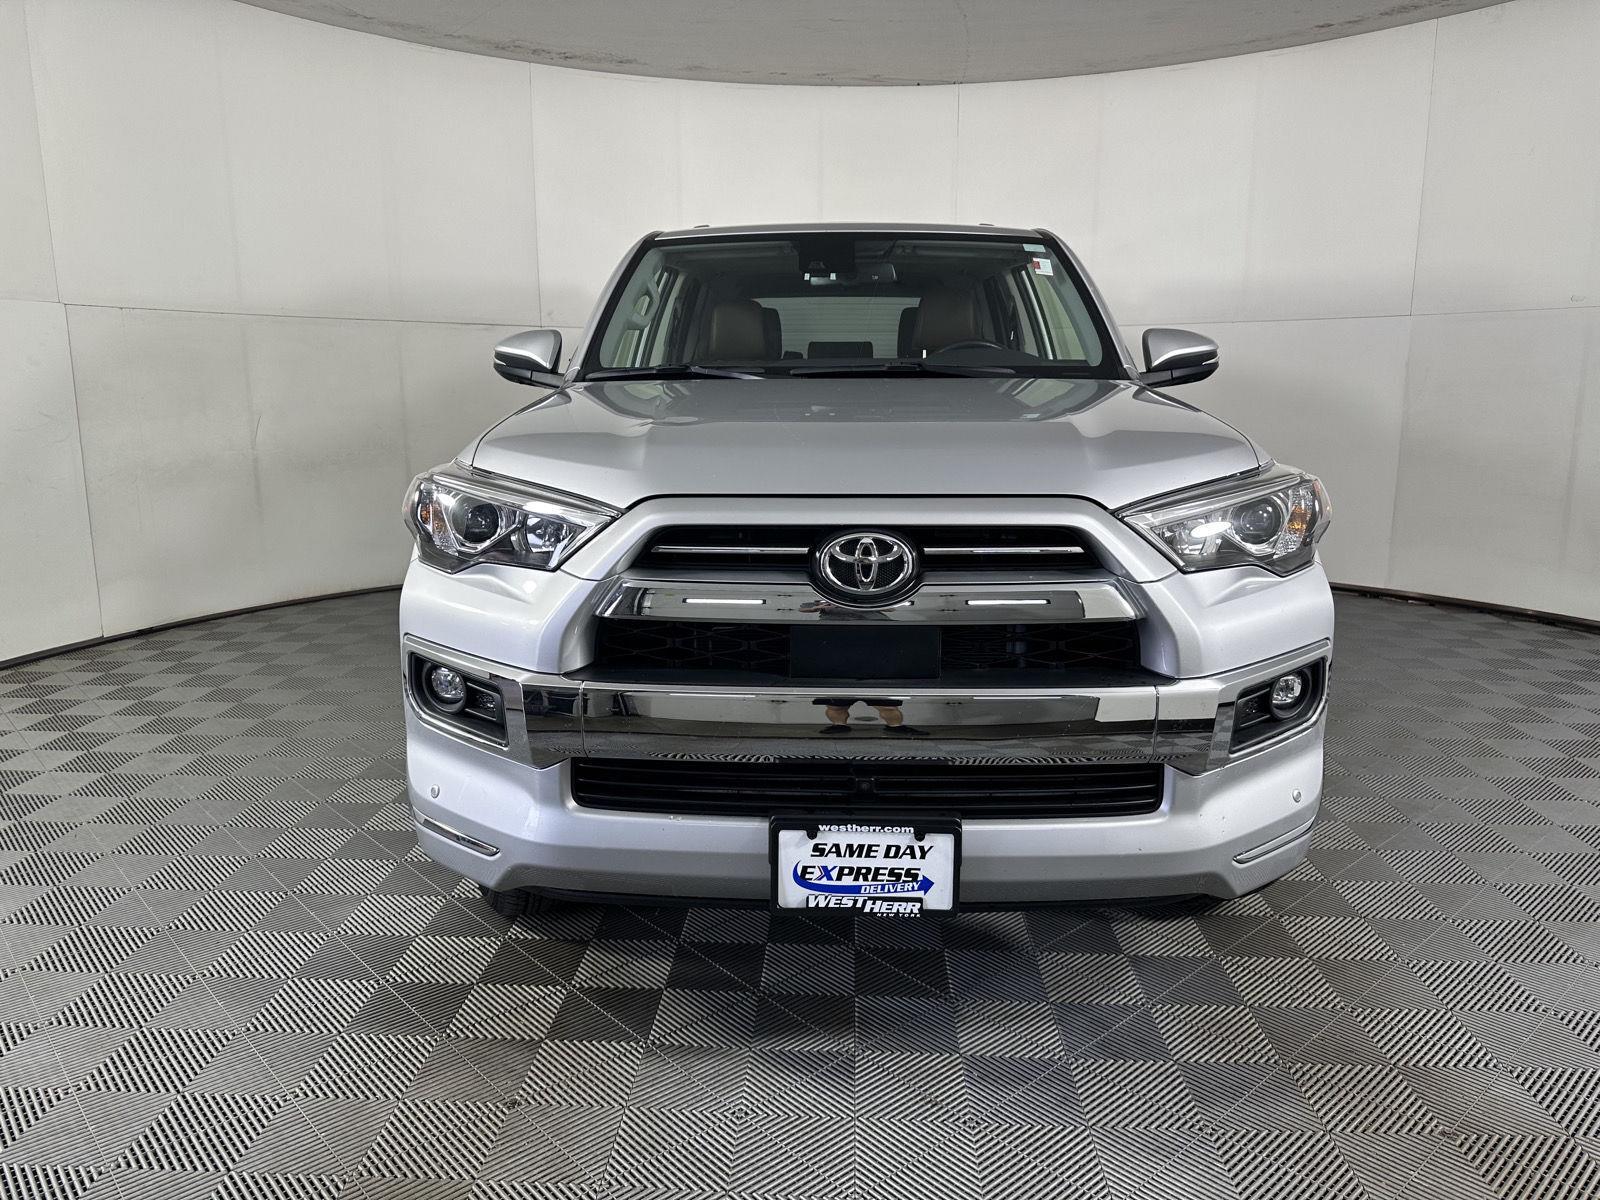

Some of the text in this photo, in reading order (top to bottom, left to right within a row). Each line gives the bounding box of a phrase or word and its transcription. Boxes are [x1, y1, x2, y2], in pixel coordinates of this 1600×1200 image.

[818, 824, 914, 834] westherr.com
[810, 842, 934, 860] SAME DAY
[800, 865, 921, 883] EXPRESS
[860, 882, 921, 894] DELIVERY
